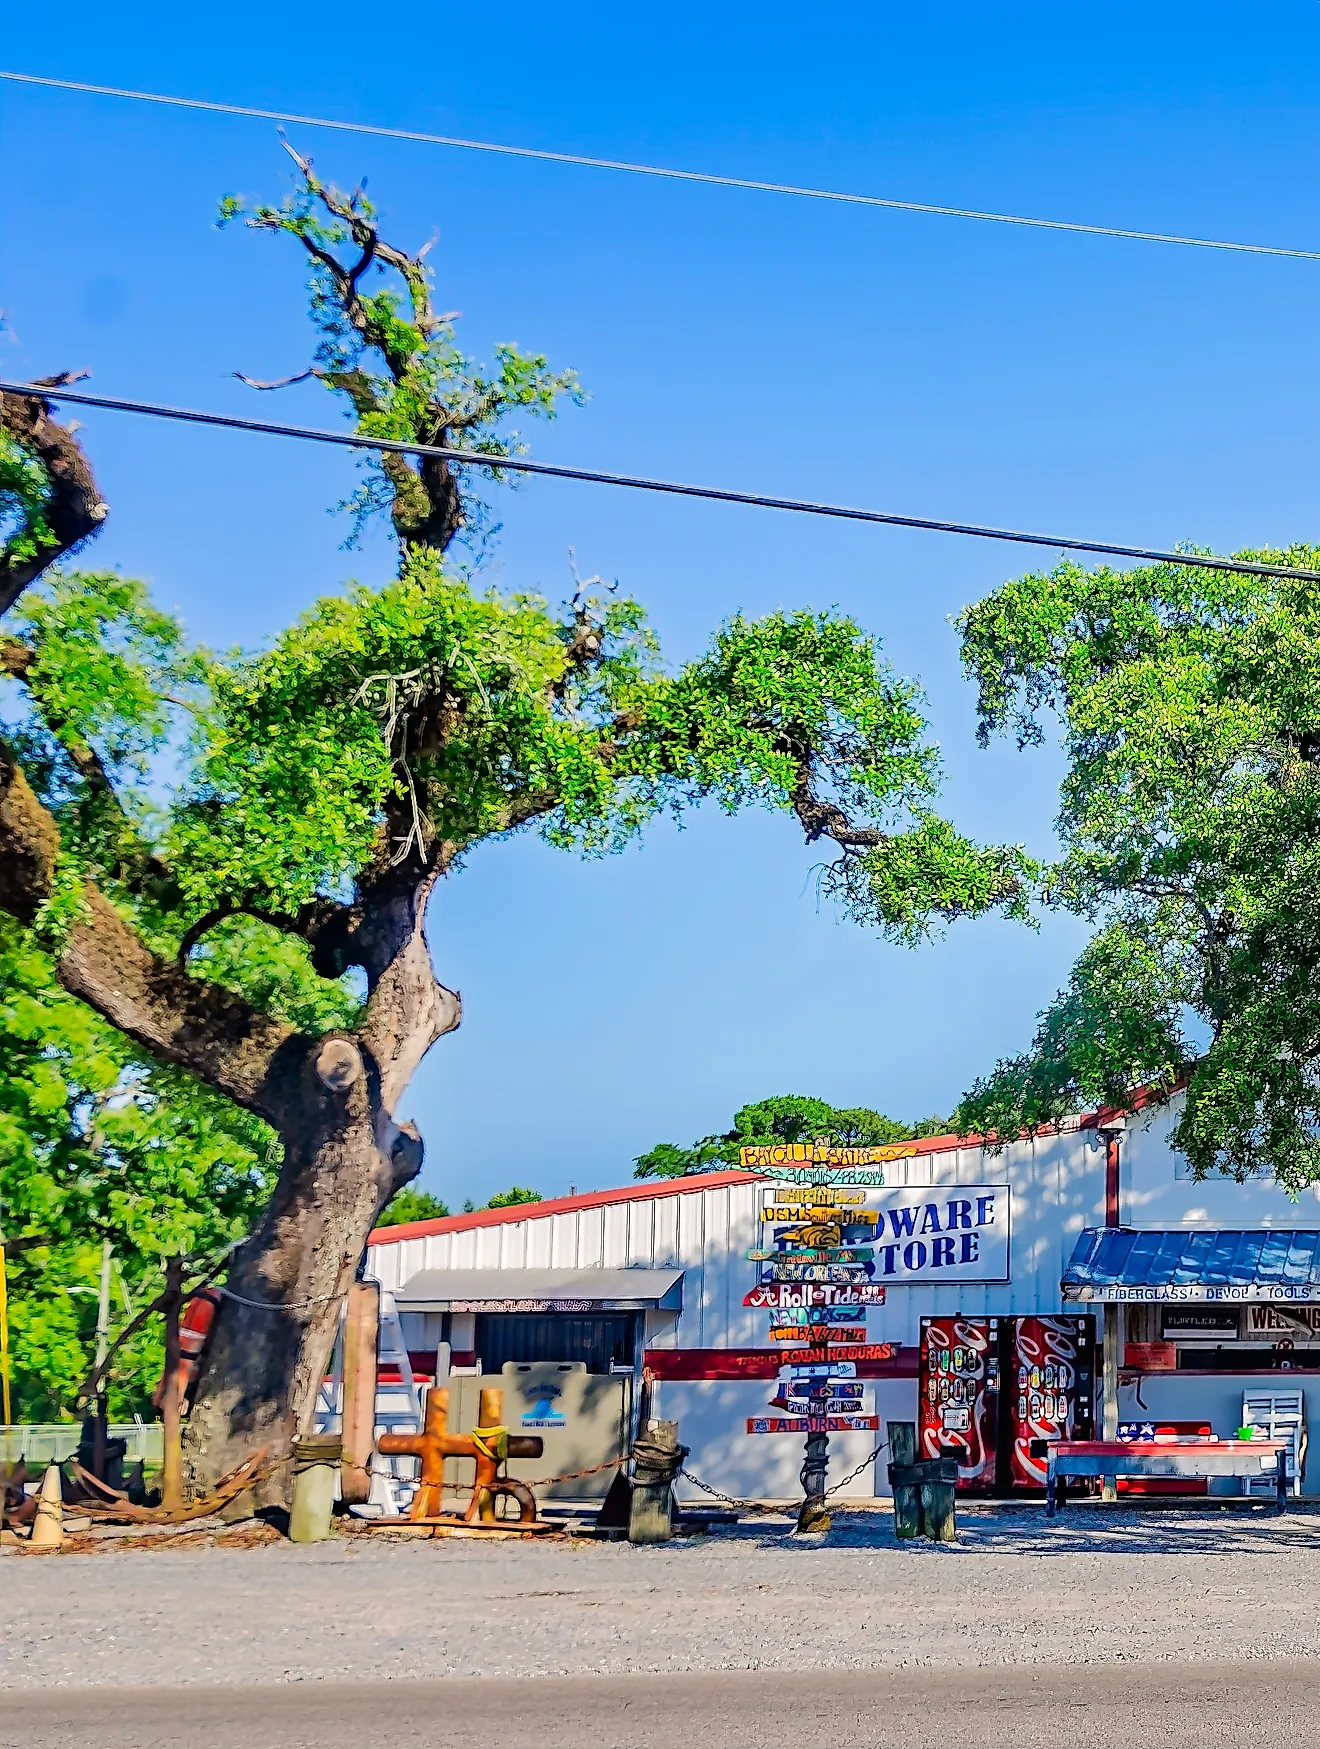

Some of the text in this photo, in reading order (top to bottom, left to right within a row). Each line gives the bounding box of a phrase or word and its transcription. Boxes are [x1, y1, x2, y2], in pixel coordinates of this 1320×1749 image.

[872, 1195, 995, 1241] WARE
[780, 1285, 814, 1308] Roll
[820, 1285, 859, 1305] Tide
[1108, 1288, 1188, 1299] FIBERGLASS
[1268, 1287, 1310, 1298] TOOLS
[776, 1418, 839, 1432] AUBURN
